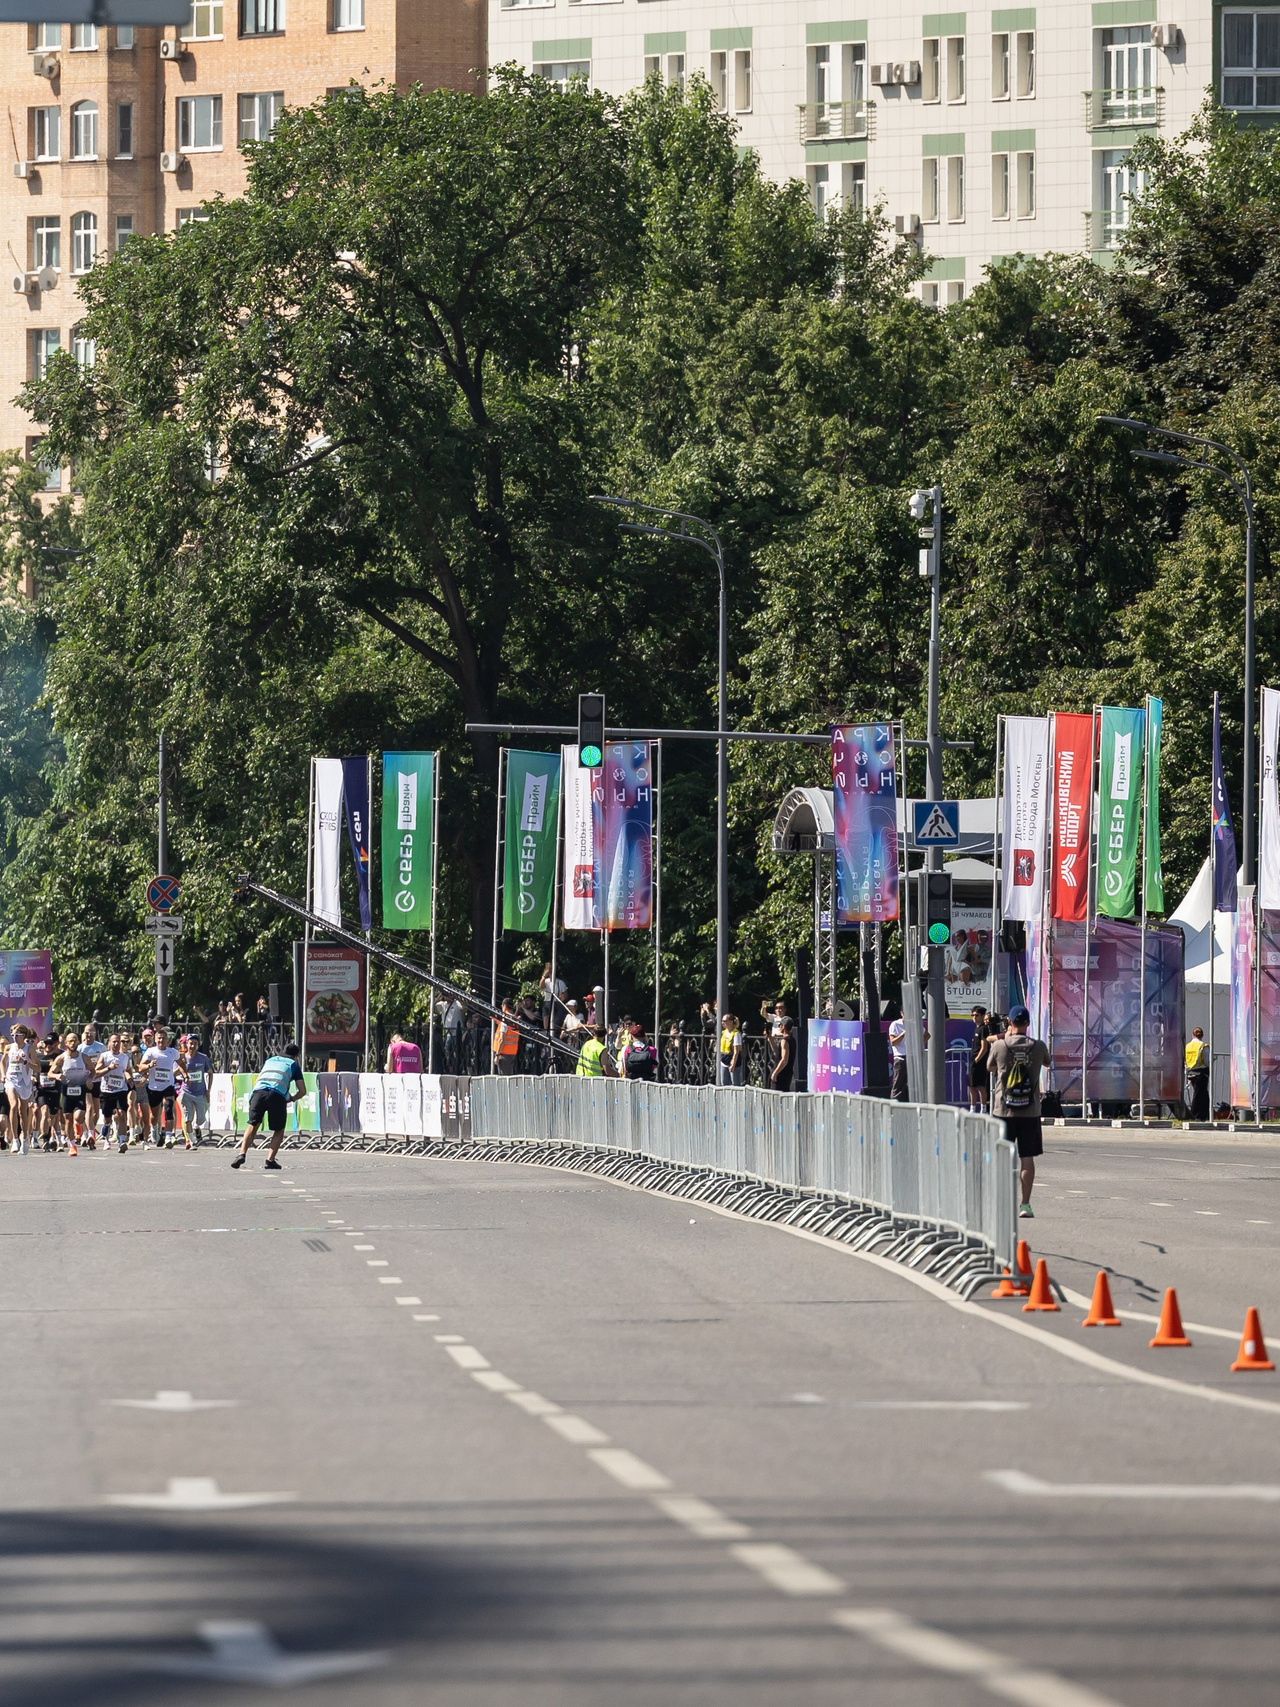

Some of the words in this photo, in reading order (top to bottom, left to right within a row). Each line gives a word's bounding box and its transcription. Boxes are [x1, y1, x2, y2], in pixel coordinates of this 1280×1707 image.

[1031, 753, 1043, 799] Москвы
[1058, 751, 1075, 847] МОСКОВСКИЙ
[527, 784, 540, 825] Прайм
[1028, 801, 1038, 842] города
[1067, 802, 1082, 848] СПОРТ
[1108, 804, 1125, 864] СБЕР
[1117, 744, 1126, 792] Прайм
[521, 834, 536, 887] СБЕР
[9, 990, 27, 998] СПОРТ
[946, 987, 982, 995] STUDIO
